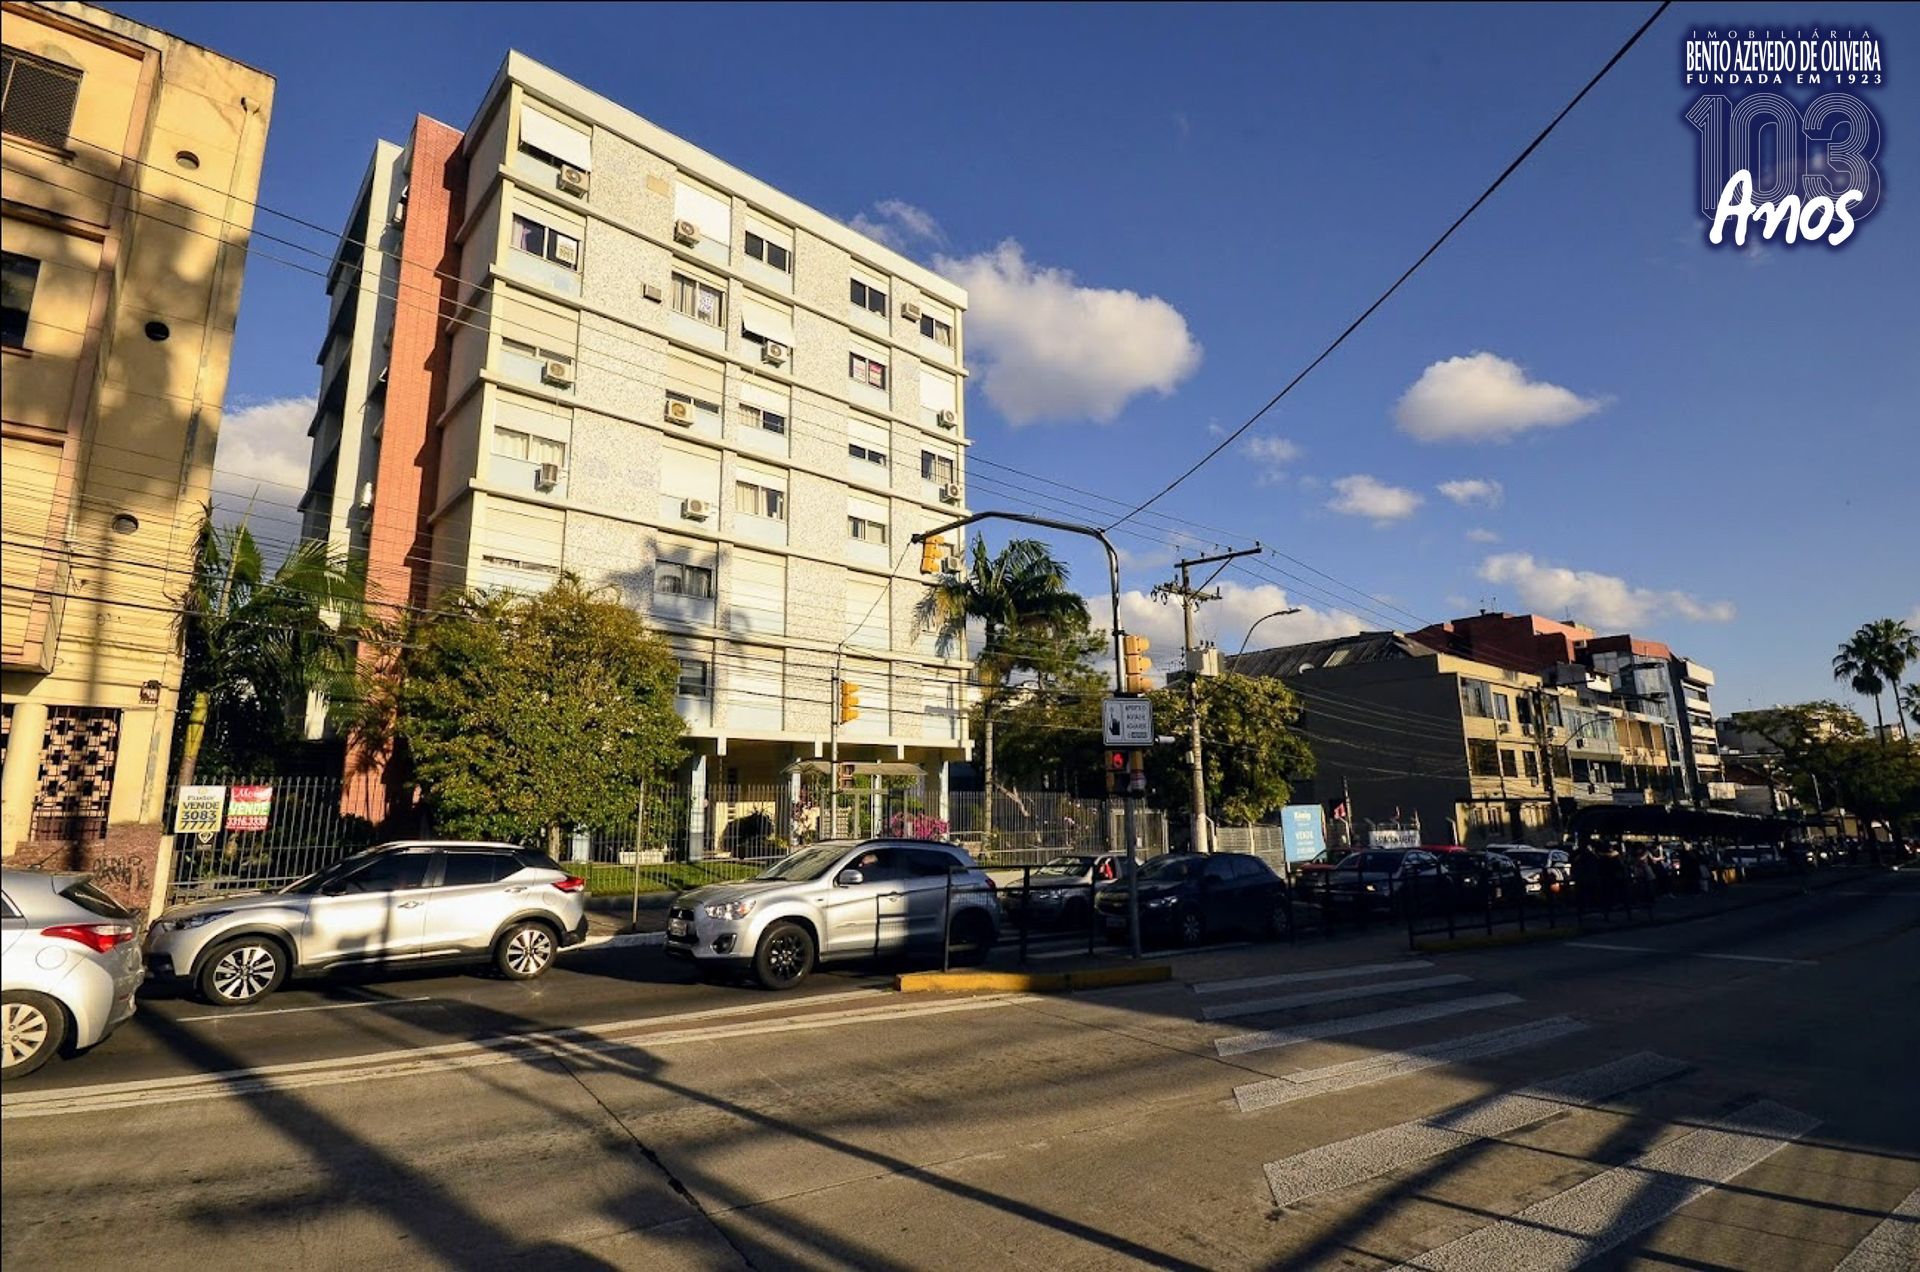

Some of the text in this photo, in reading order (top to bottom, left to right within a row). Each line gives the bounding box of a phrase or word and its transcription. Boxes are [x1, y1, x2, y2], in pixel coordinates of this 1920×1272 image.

[183, 801, 220, 810] VENDE
[181, 810, 217, 820] 3083
[180, 820, 217, 830] 7777
